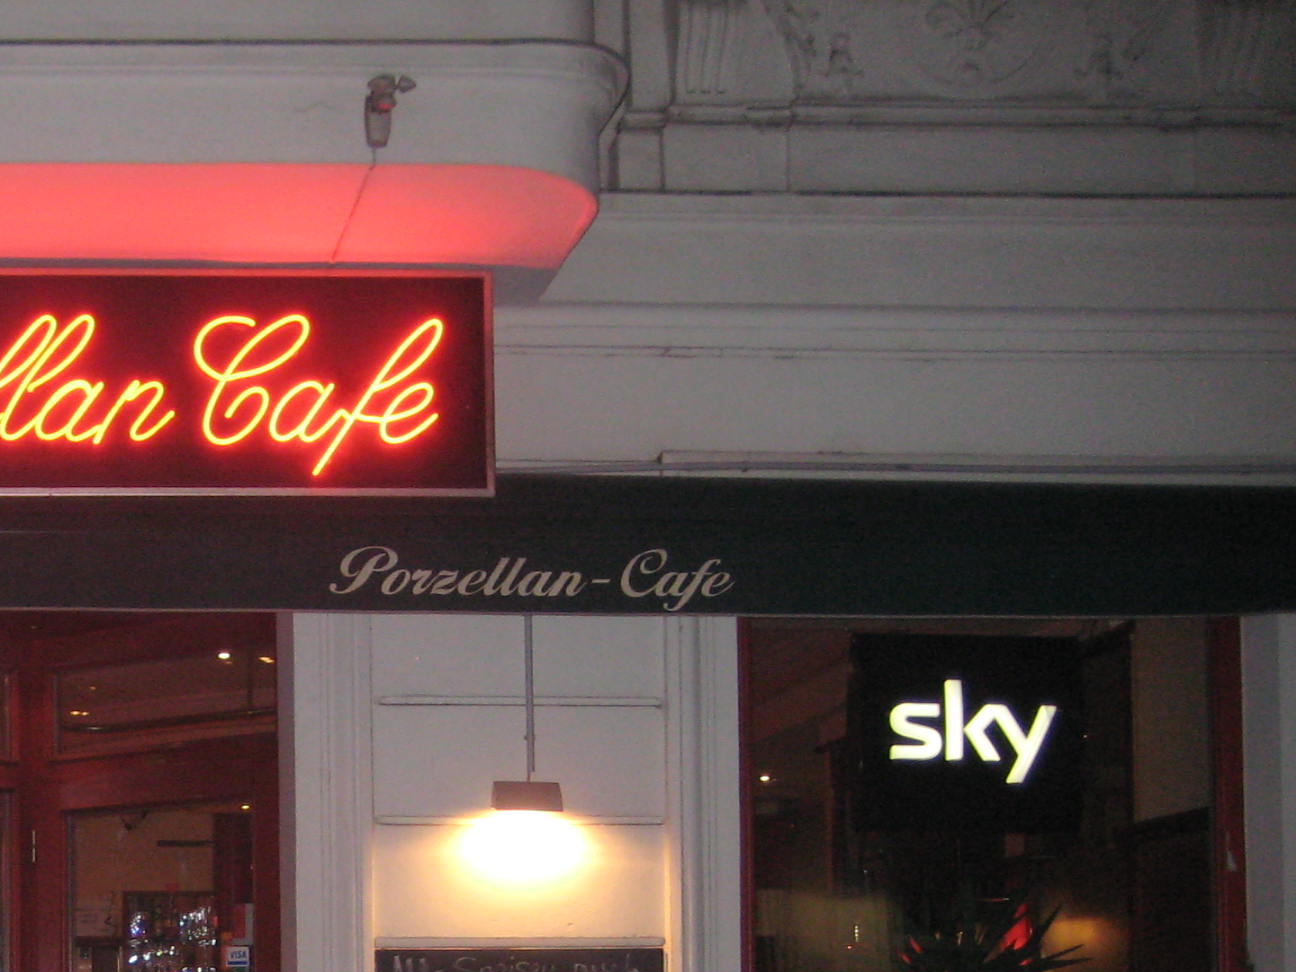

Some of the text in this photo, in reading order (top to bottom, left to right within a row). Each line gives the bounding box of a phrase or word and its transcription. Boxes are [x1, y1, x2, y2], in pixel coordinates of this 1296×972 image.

[191, 311, 445, 478] Cafe
[619, 548, 737, 612] Cafe
[889, 678, 1058, 785] sky
